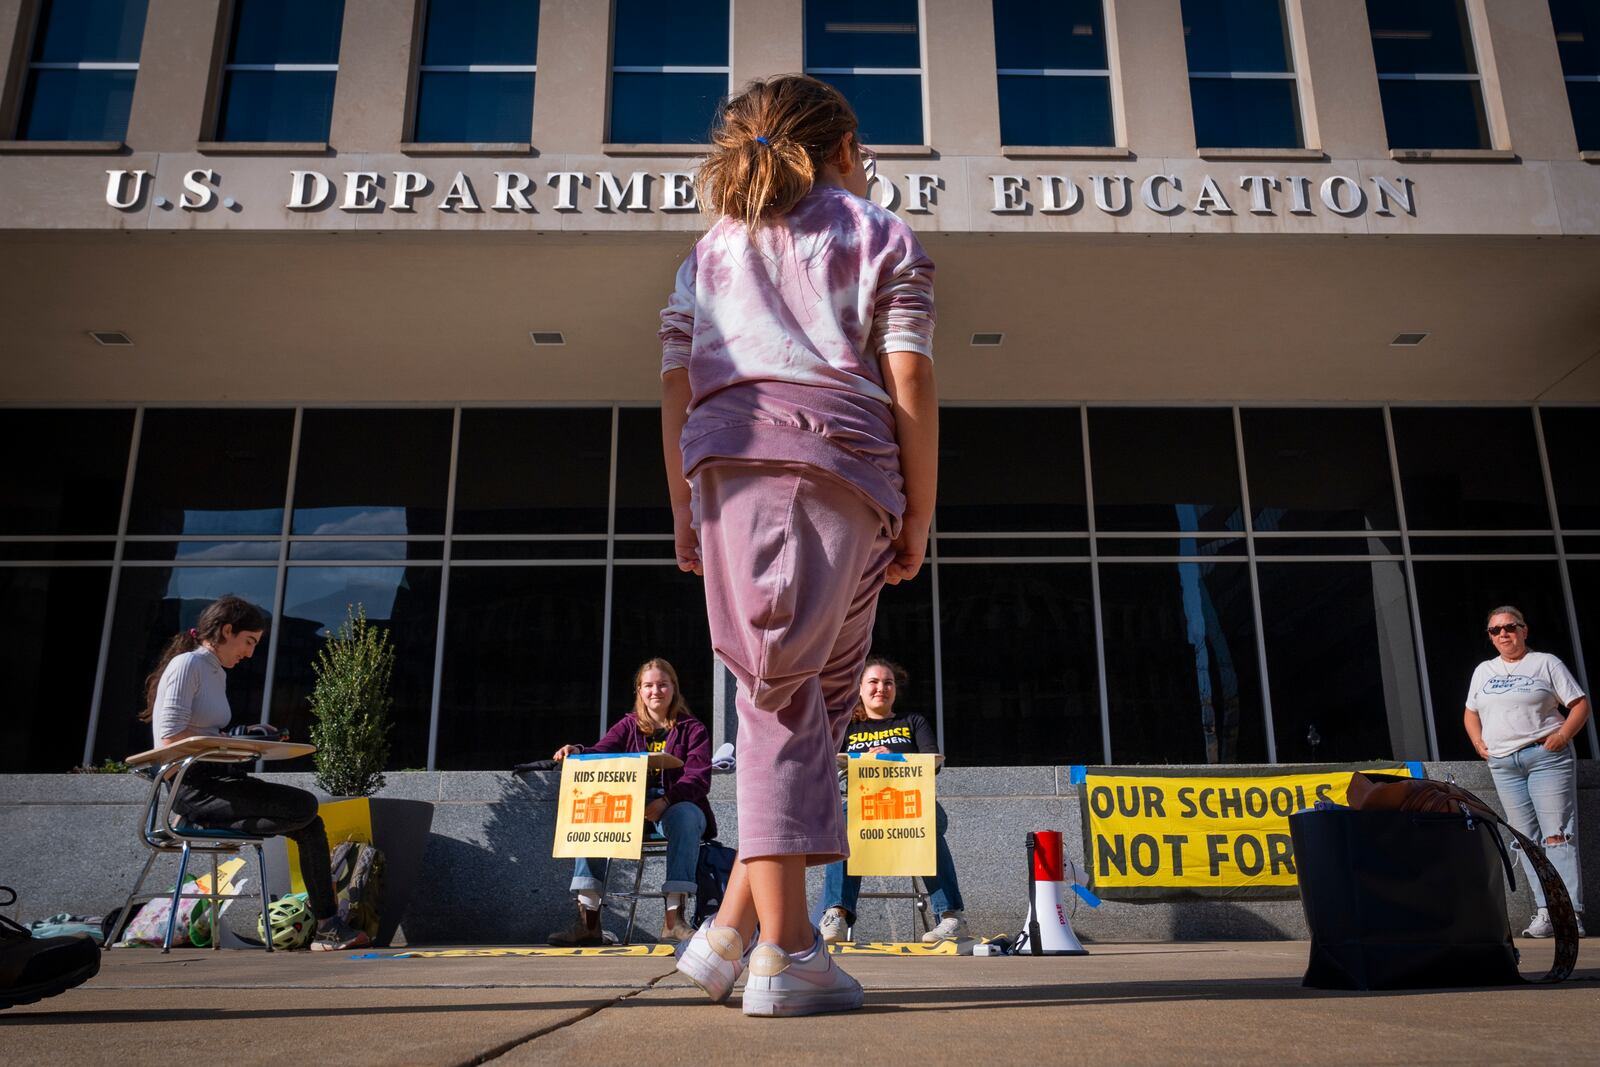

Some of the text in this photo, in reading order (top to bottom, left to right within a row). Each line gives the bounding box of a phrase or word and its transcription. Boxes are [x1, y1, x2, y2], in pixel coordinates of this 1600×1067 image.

[105, 169, 236, 208] U.S.
[288, 170, 697, 212] DEPARTME
[988, 174, 1417, 216] EDUCATION
[848, 727, 911, 744] SUNRISE
[573, 771, 595, 783] KIDS
[597, 771, 637, 783] DESERVE
[858, 765, 923, 779] KIDS DESERVE
[1090, 786, 1167, 819] OUR
[566, 831, 632, 843] GOOD SCHOOLS
[860, 827, 926, 840] GOOD SCHOOLS
[1097, 833, 1296, 877] NOT FOR
